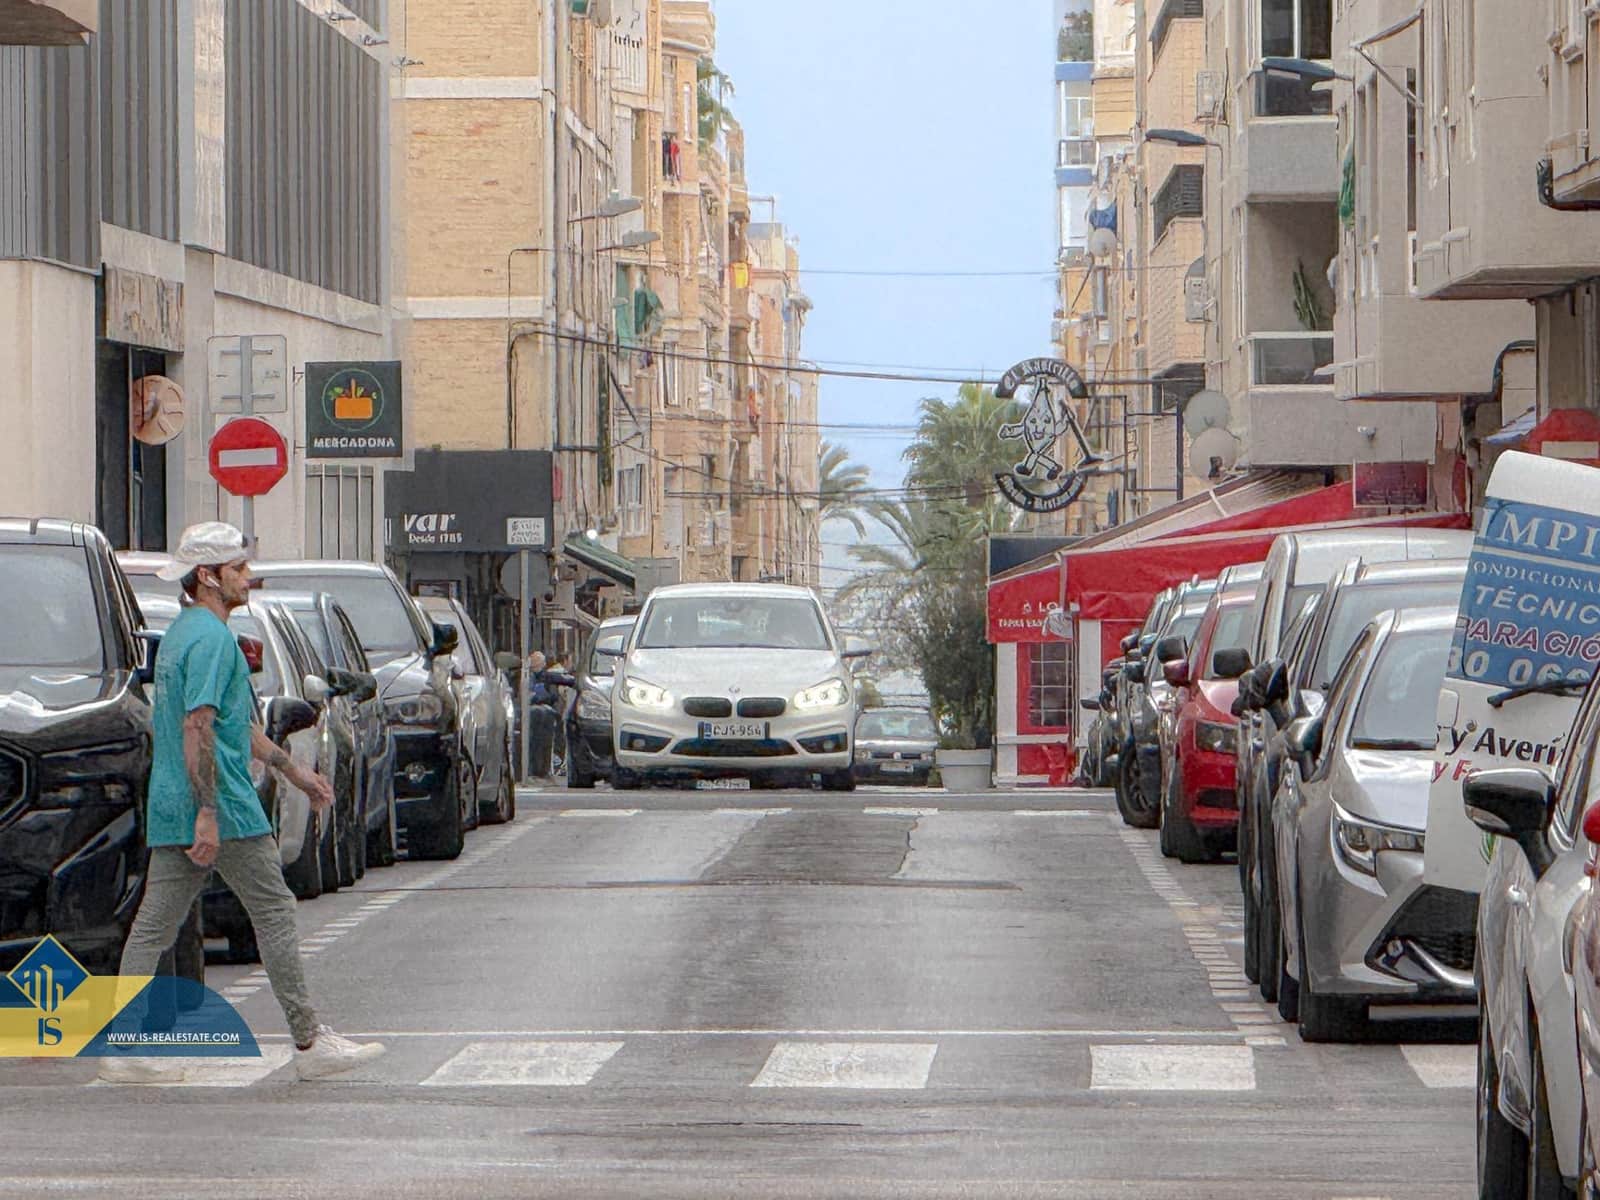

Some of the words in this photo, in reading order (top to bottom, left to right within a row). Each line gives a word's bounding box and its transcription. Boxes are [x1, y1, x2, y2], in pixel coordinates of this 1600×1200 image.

[313, 437, 396, 449] MERCADONA
[1473, 560, 1600, 595] ONDICIONA
[1475, 584, 1600, 625] TÉCNIC
[1445, 727, 1468, 756] y
[1472, 727, 1567, 766] Averí
